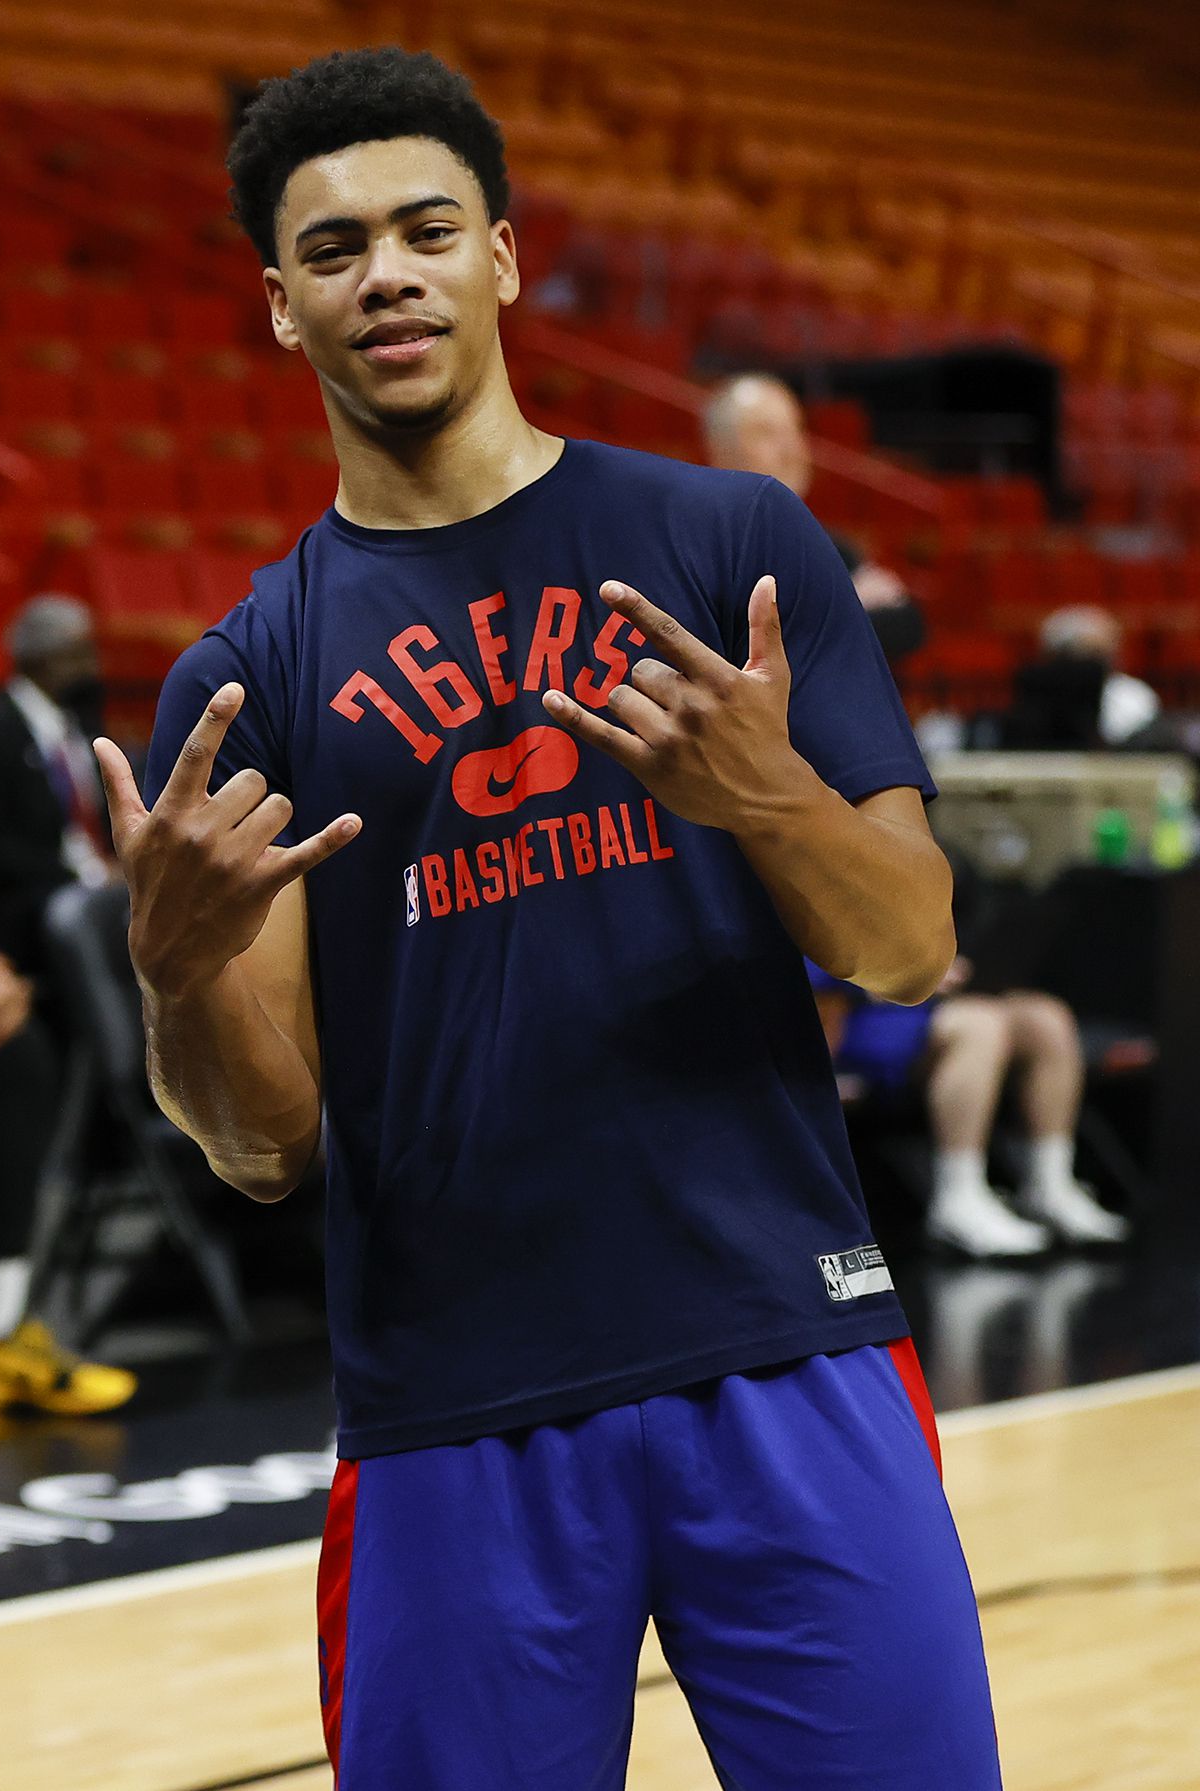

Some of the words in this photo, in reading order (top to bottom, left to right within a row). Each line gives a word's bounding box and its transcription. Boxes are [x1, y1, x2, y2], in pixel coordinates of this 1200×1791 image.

[329, 586, 646, 765] 76ERS
[421, 799, 675, 918] BASKETBALL
[845, 1259, 855, 1269] L
